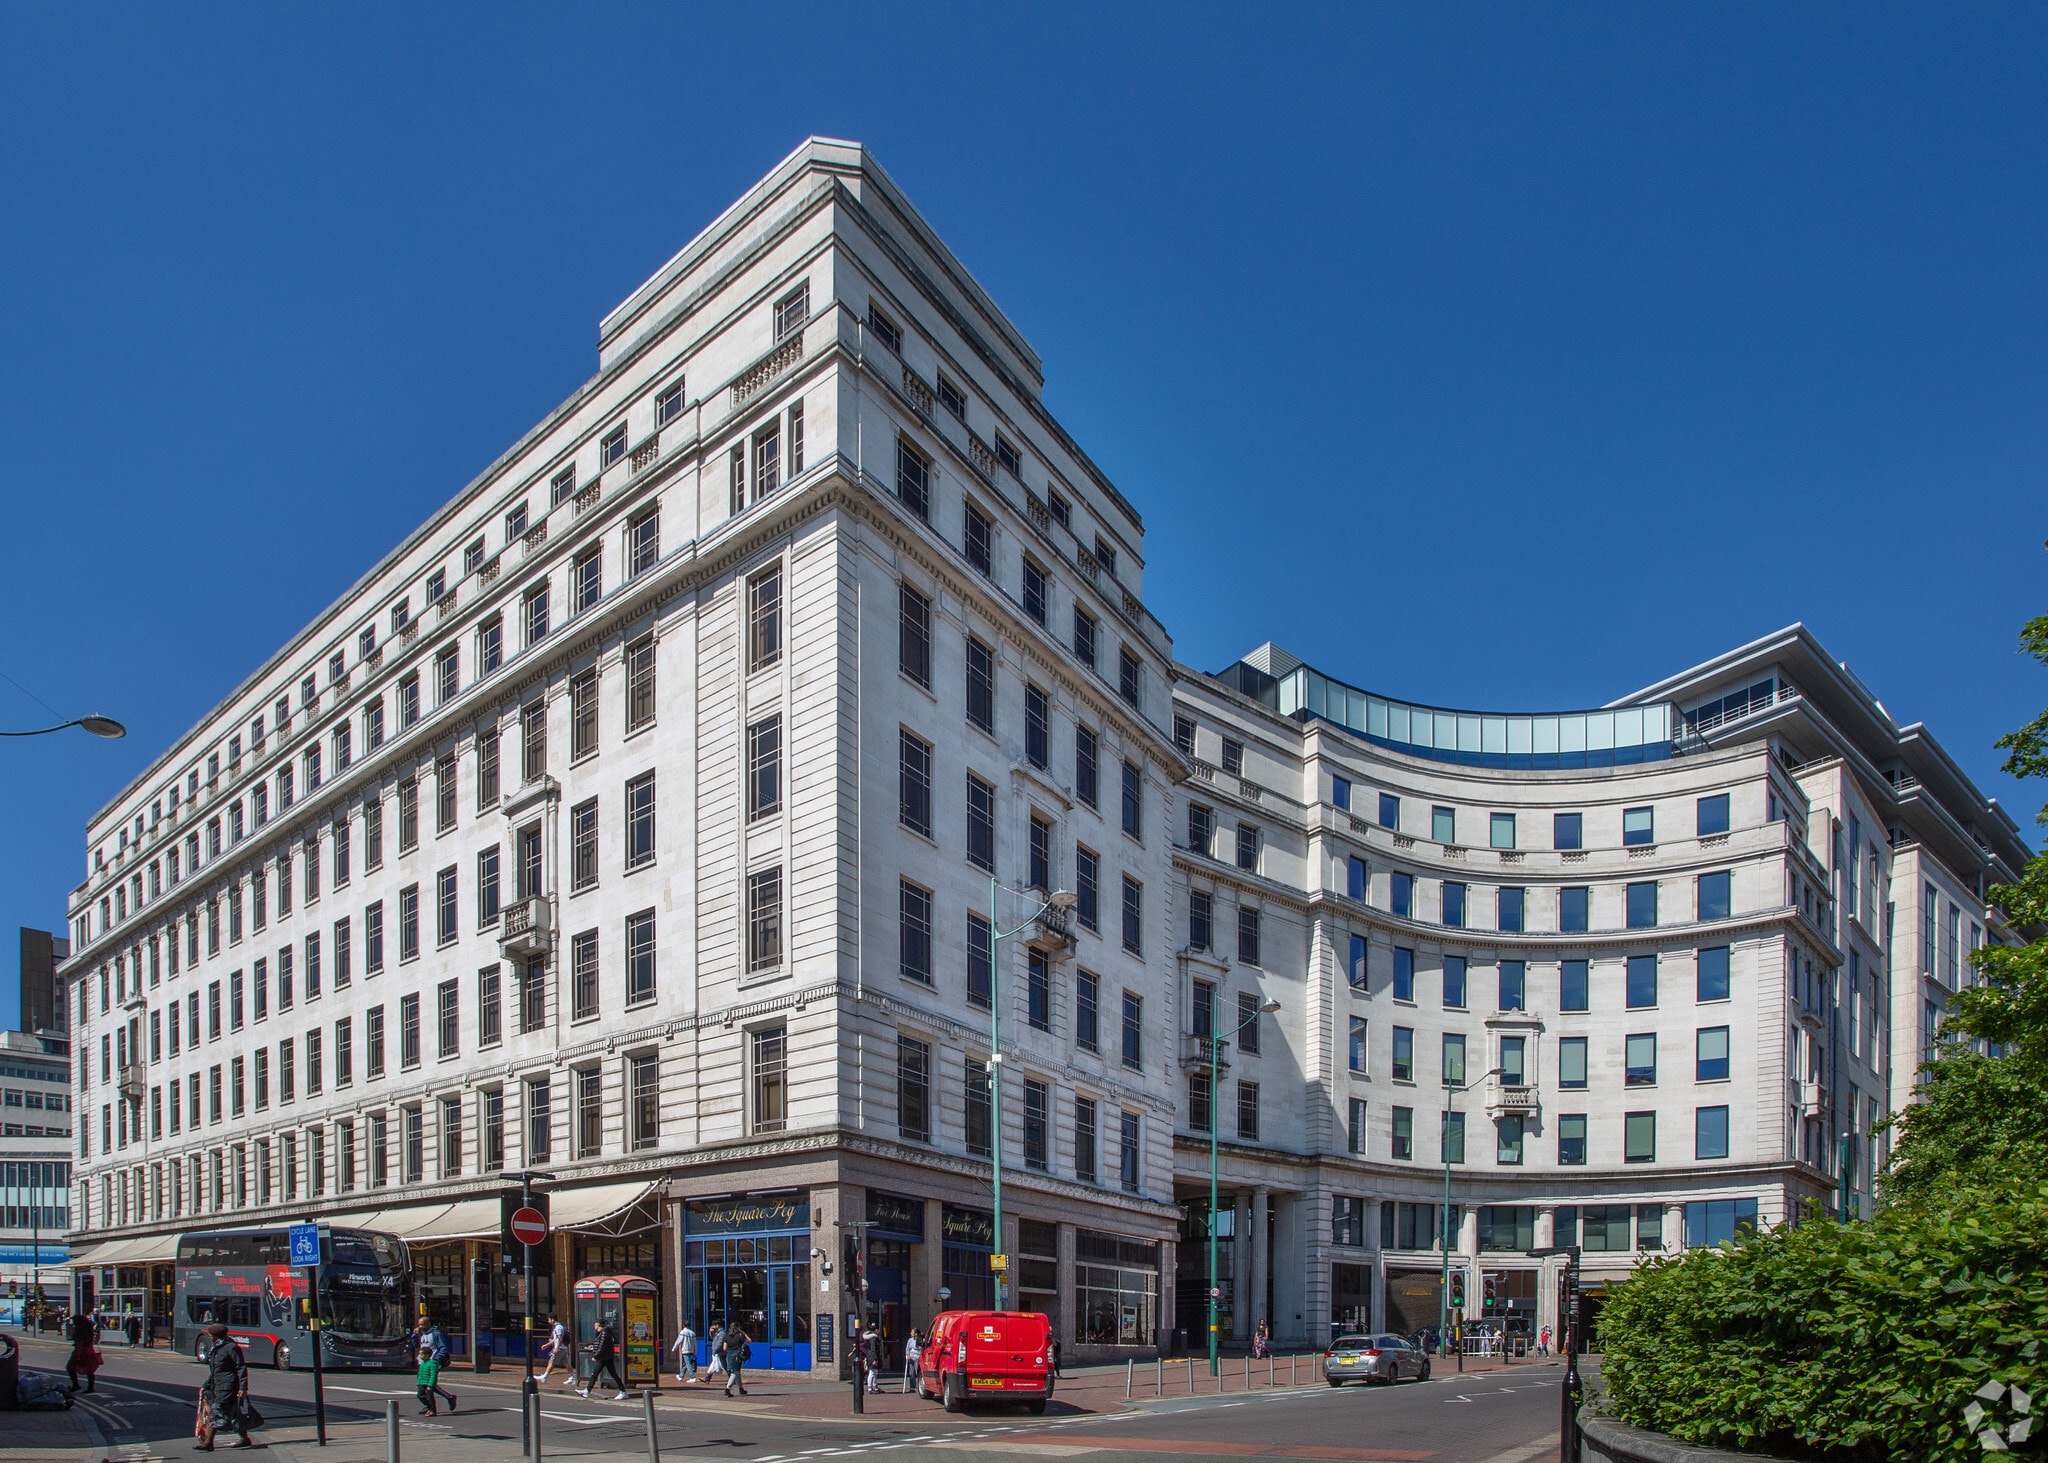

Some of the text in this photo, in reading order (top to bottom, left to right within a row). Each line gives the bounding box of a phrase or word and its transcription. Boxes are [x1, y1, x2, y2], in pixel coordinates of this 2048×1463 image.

[703, 1198, 796, 1227] The Square Peg
[291, 1225, 317, 1235] CYCLE LANE
[943, 1214, 993, 1241] Square Peg
[305, 1254, 318, 1262] RIGHT
[382, 1276, 394, 1286] X4
